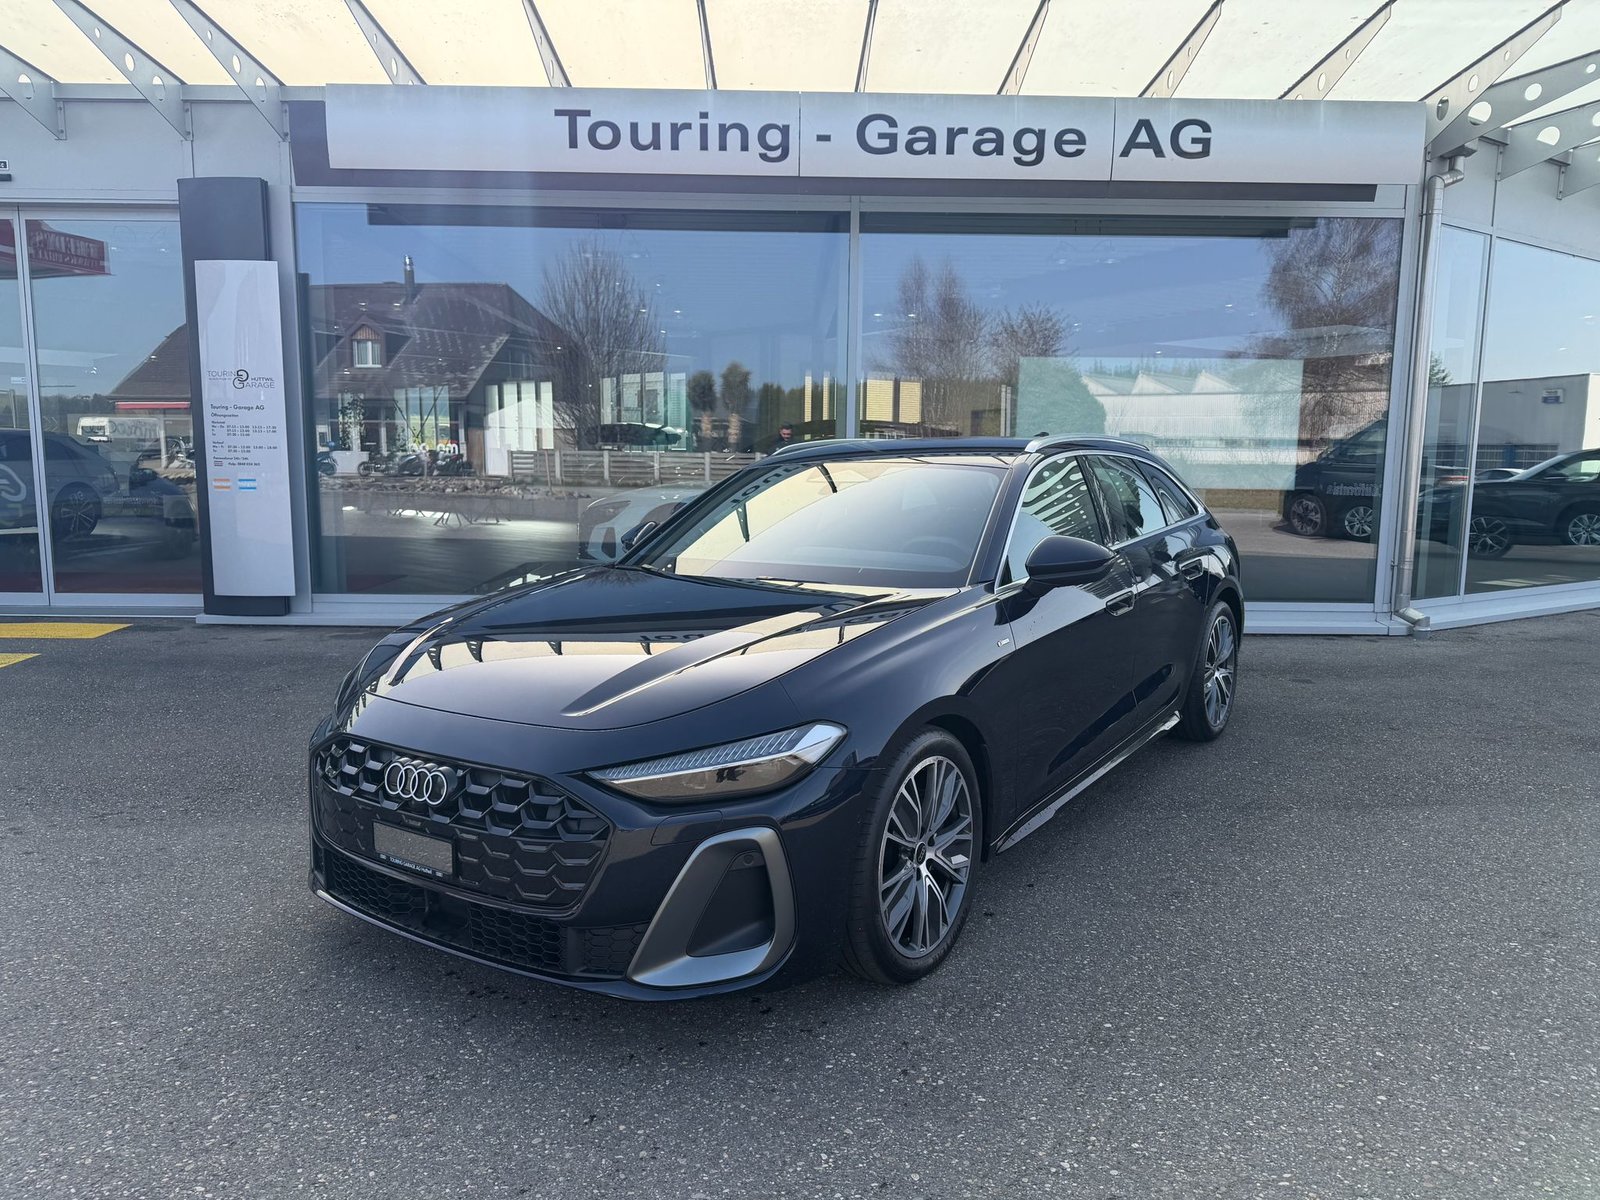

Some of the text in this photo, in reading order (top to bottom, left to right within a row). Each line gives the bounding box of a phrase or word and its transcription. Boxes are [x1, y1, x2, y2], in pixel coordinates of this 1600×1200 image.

[554, 108, 1213, 167] Touring - Garage AG
